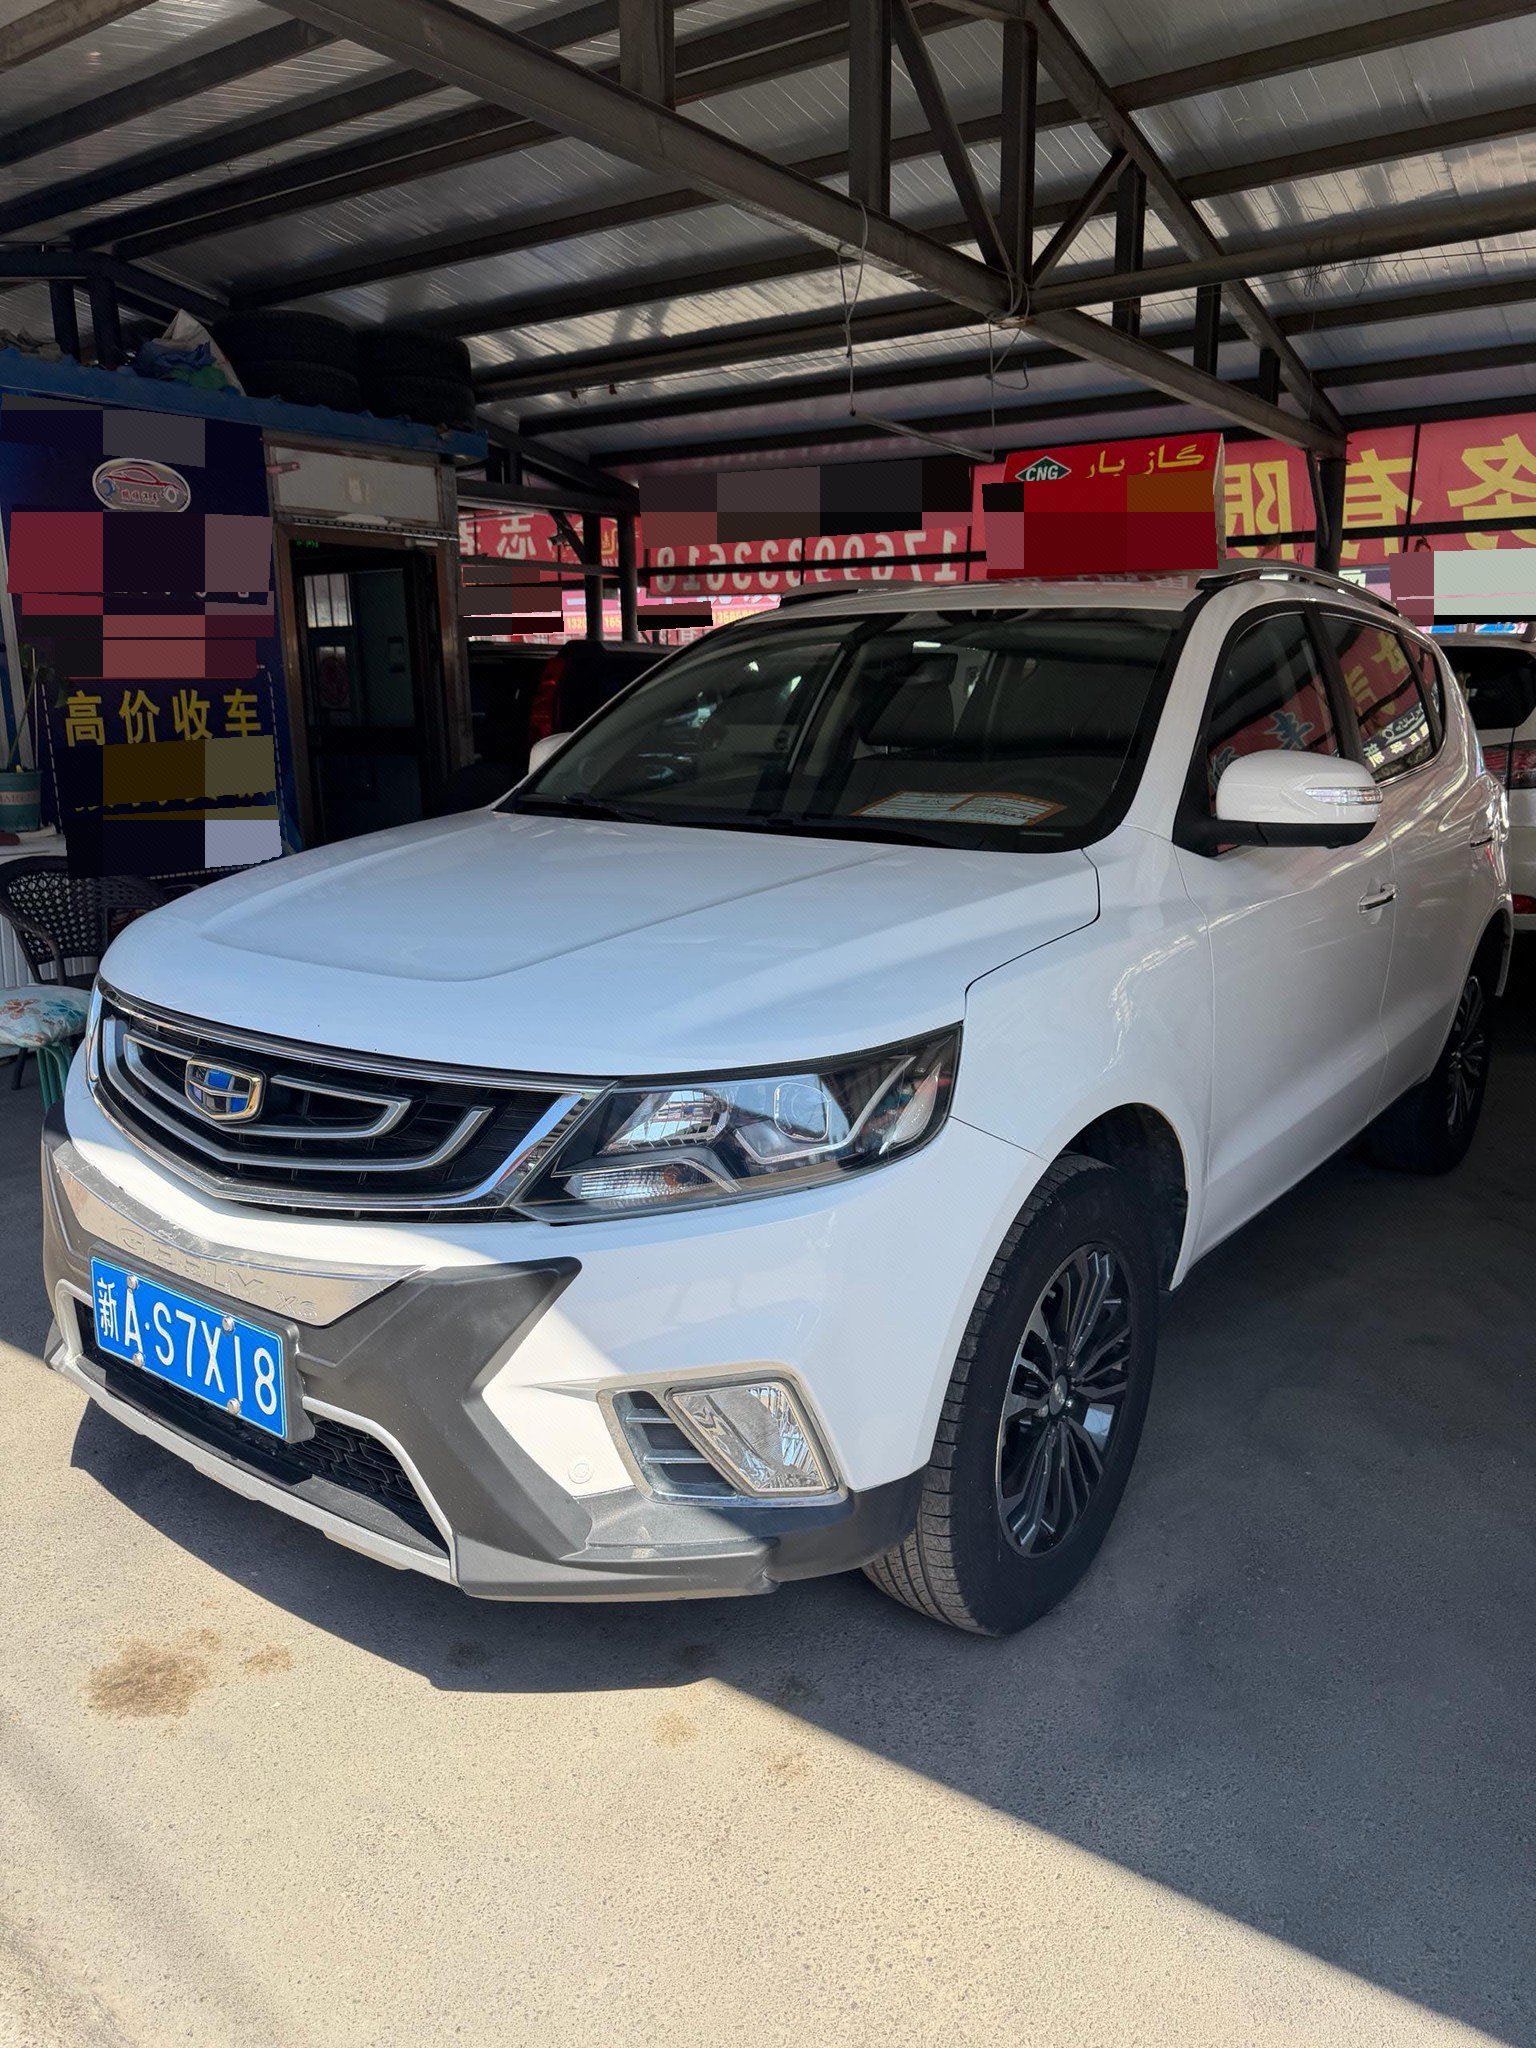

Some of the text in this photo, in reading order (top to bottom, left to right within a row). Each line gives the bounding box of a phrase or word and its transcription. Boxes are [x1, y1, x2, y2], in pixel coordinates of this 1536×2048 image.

[1025, 464, 1058, 482] CNG
[1143, 444, 1205, 475] گاز
[64, 688, 262, 747] 高价收车
[115, 1227, 264, 1293] GEELY
